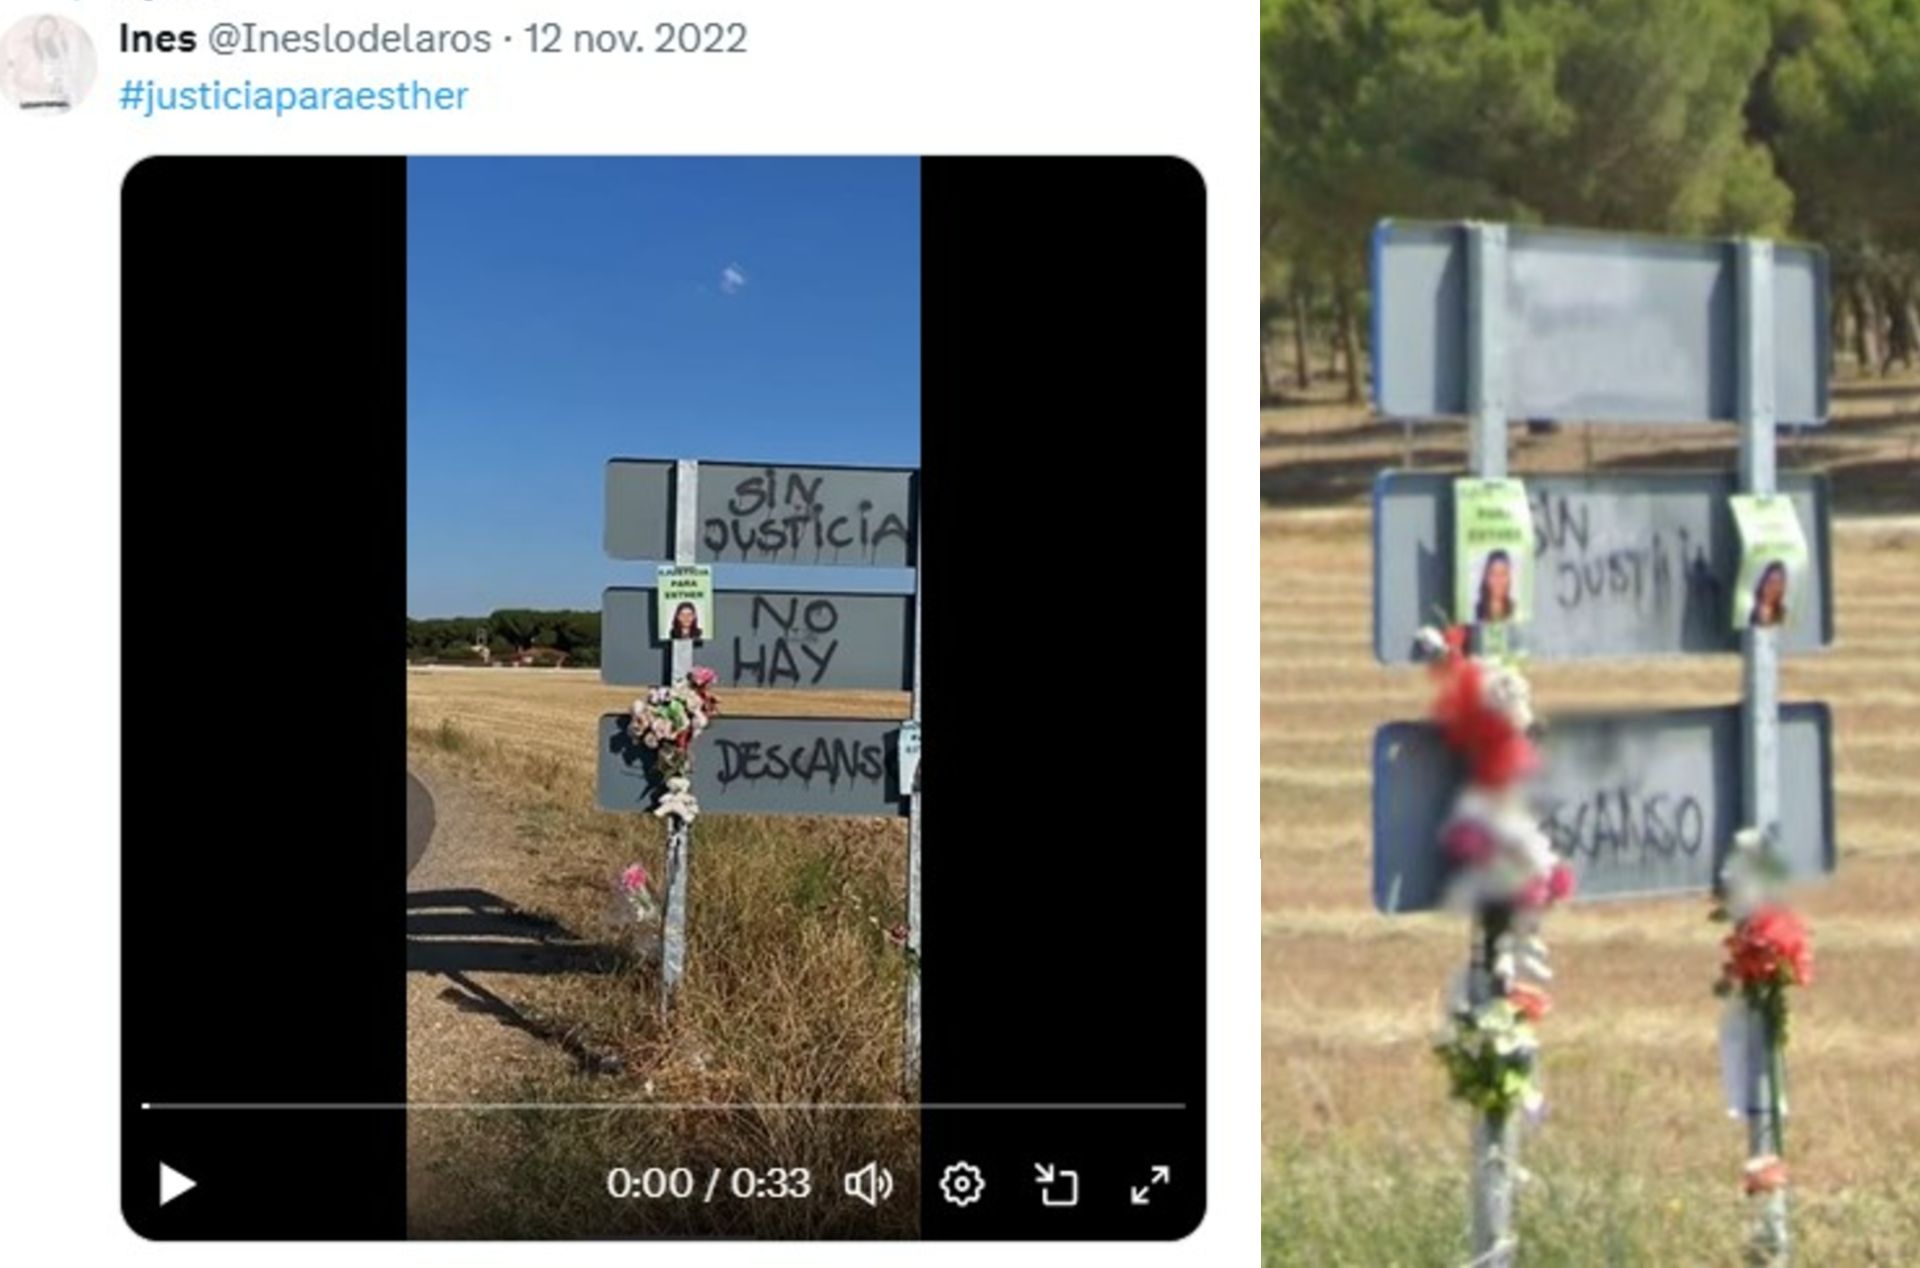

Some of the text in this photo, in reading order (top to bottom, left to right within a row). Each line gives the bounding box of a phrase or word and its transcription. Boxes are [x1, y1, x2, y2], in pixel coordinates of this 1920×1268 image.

[119, 22, 198, 53] Ines
[208, 22, 492, 55] @Ineslodelaros
[523, 22, 563, 53] 12
[574, 28, 644, 53] nov.
[654, 22, 748, 53] 2022
[118, 79, 470, 119] #justiciaparaesther
[730, 469, 823, 516] SIN
[704, 500, 910, 556] JUSTICIA
[752, 595, 838, 635] NO
[732, 636, 839, 688] HAY
[714, 737, 884, 791] DESCANS
[607, 1167, 811, 1203] 0:00 / 0:33
